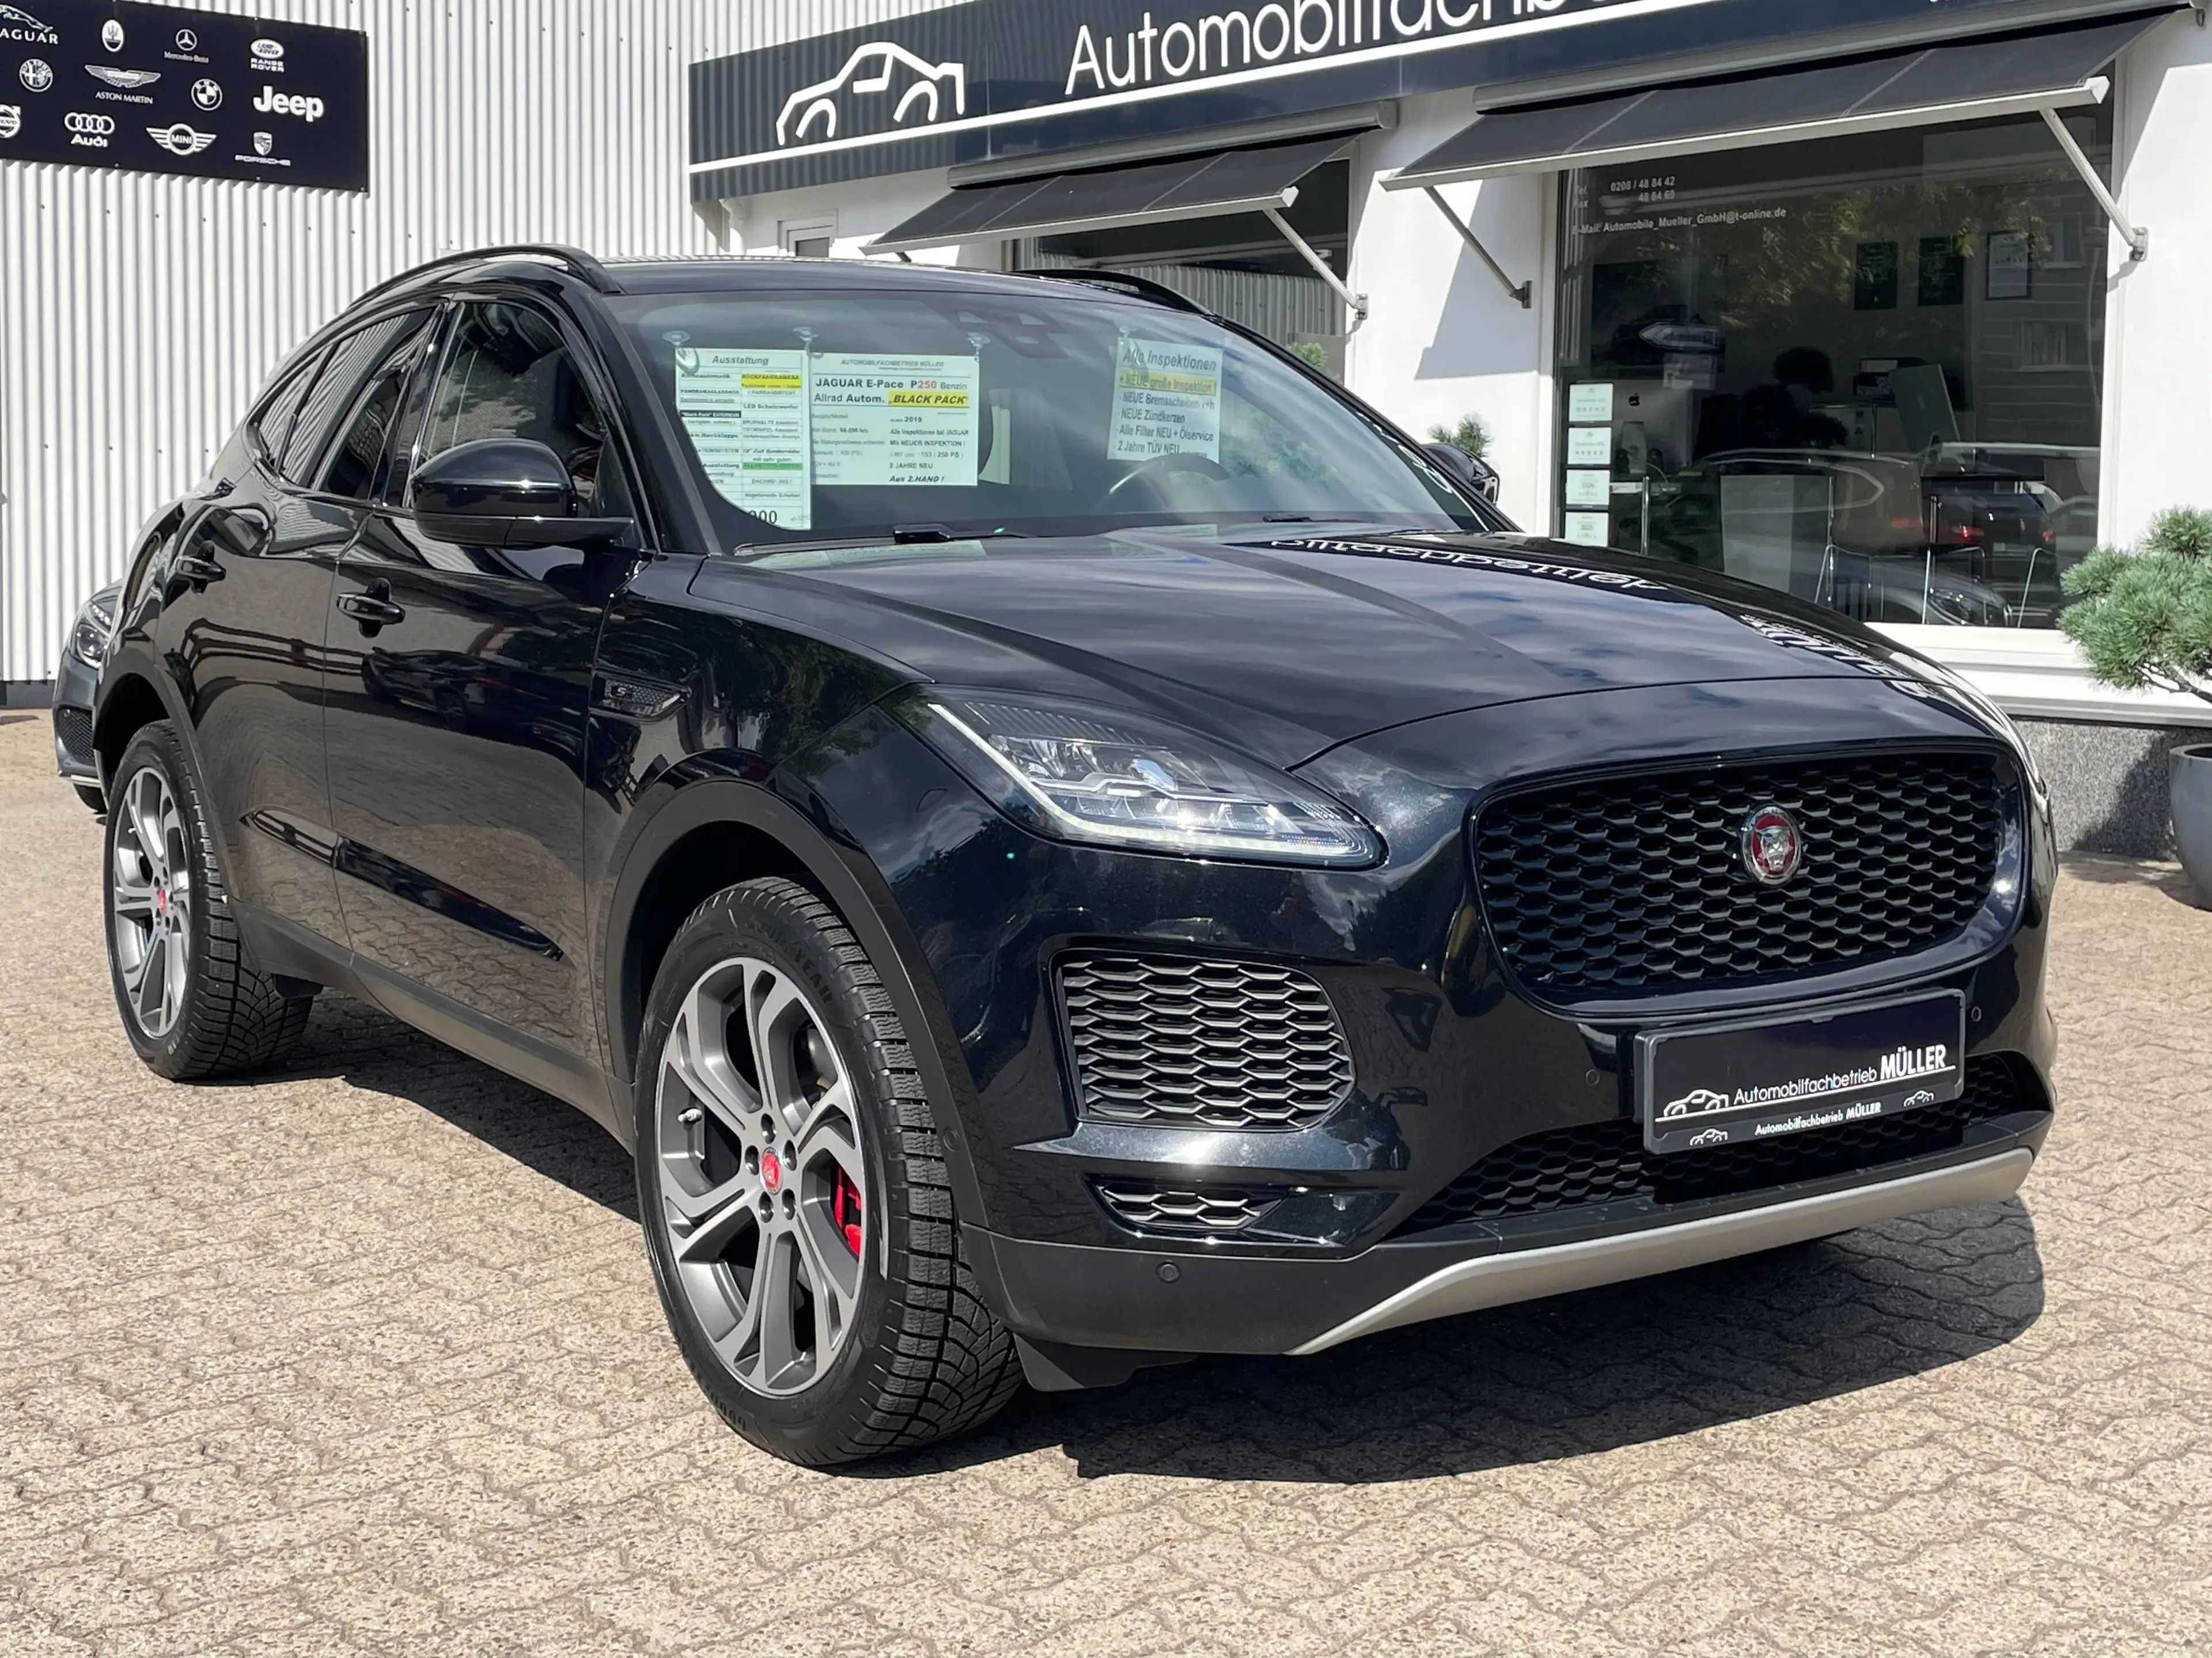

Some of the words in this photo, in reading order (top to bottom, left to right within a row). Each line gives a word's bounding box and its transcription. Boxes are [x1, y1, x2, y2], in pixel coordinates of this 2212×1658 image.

[164, 51, 209, 63] Mercedes-Benz
[251, 58, 284, 67] RANGE
[251, 64, 285, 73] ROVER
[96, 92, 122, 101] ASTON
[123, 95, 153, 104] MARTIN
[253, 85, 324, 122] Jeep
[70, 134, 108, 147] Audi
[171, 134, 192, 145] MINI
[234, 154, 291, 166] PORSCHE
[1664, 176, 1675, 187] 42
[712, 355, 768, 366] Ausstattung
[1123, 348, 1145, 364] Alle
[1147, 350, 1216, 371] Inspektionen
[816, 378, 863, 388] JAGUAR
[866, 379, 904, 388] E-Pace
[911, 380, 937, 389] P250
[940, 382, 968, 390] Benzin
[1125, 373, 1149, 387] NEUE
[1150, 377, 1172, 390] große
[1173, 379, 1212, 393] Inspektion
[813, 393, 843, 403] Allrad
[846, 394, 885, 403] Autom.
[1123, 391, 1145, 404] NEUE
[1145, 393, 1199, 408] Bremsscheiben
[1121, 408, 1143, 420] NEUE
[1143, 409, 1185, 423] Zündkerzen
[1119, 423, 1134, 436] Alle
[1135, 424, 1154, 437] Filter
[1156, 427, 1172, 439] NEU
[1180, 424, 1214, 442] Ölservice
[1117, 440, 1123, 452] 2
[1124, 441, 1145, 453] Jahre
[1147, 439, 1162, 454] TÜV
[1163, 443, 1180, 454] NEU
[1734, 1067, 1877, 1106] Automobilfachbetrieb
[1880, 1044, 1946, 1080] MÜLLER
[1755, 1109, 1844, 1136] Automobilfachbetrieb
[1846, 1101, 1882, 1120] MÜLLER
